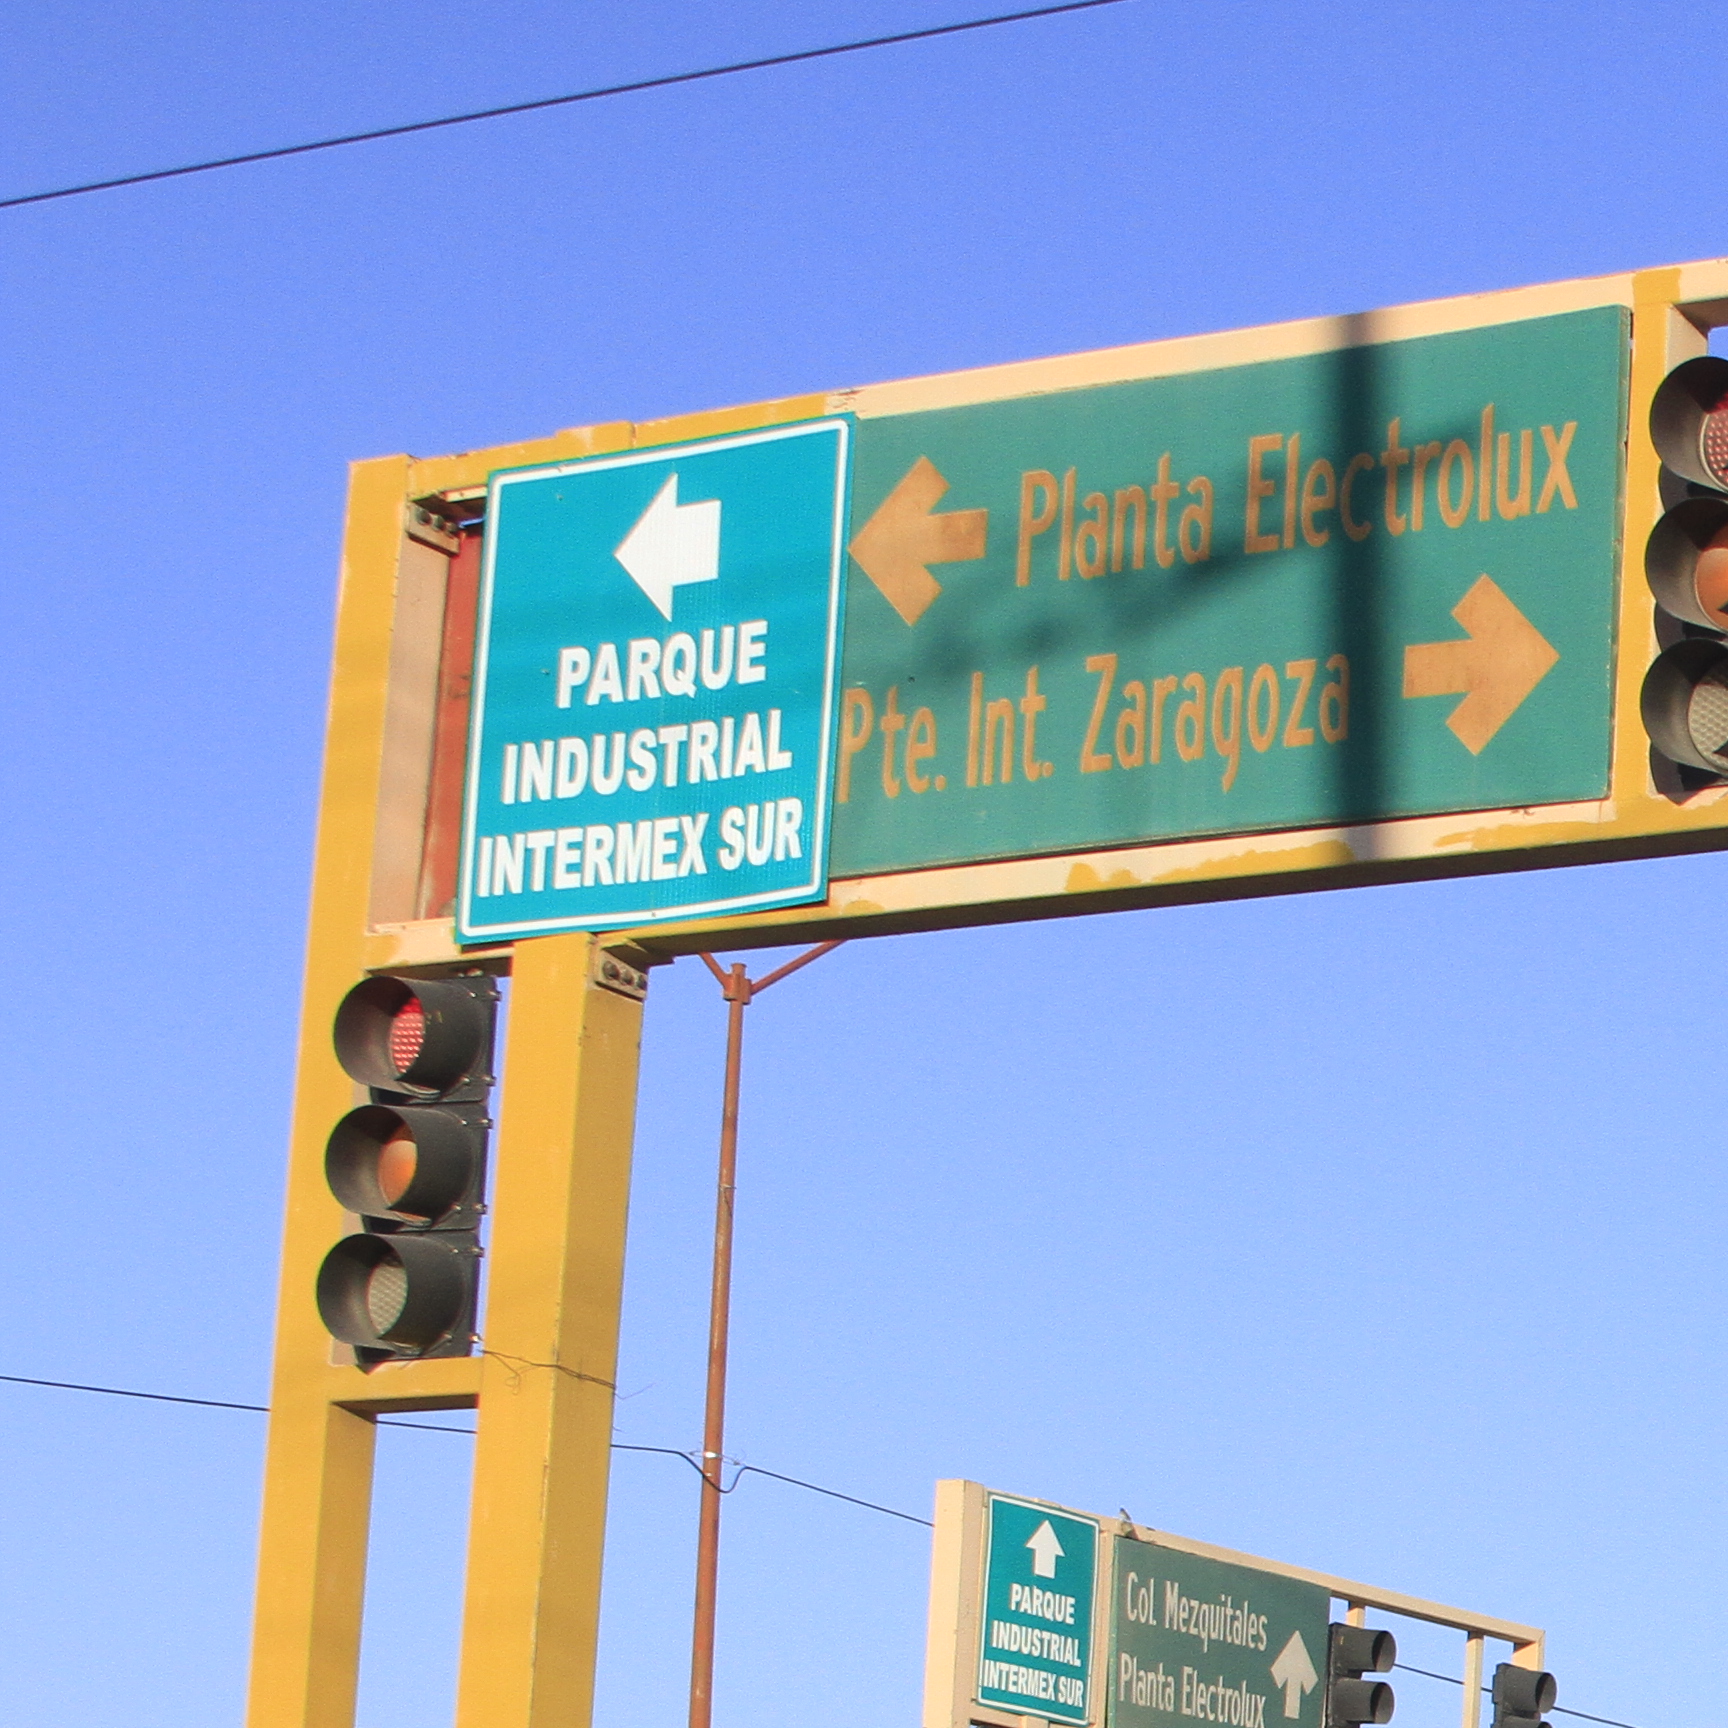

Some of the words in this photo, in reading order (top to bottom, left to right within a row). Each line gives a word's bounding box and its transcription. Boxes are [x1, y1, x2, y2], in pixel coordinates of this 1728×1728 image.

[1016, 452, 1215, 587] Planta
[1245, 402, 1580, 556] Electrolux
[556, 620, 769, 708] PARQUE
[502, 708, 792, 805] INDUSTRIAL
[843, 686, 946, 804] Pte.
[966, 668, 1053, 785] Int.
[1080, 650, 1351, 794] Zaragoza
[478, 811, 709, 898] INTERMEX
[716, 797, 804, 868] SUR
[991, 1620, 1082, 1666] INDUSTRIAL
[1010, 1582, 1075, 1625] PARQUE
[1127, 1571, 1157, 1622] Col.
[1165, 1579, 1268, 1653] Mezquitales
[983, 1659, 1055, 1703] INTERMEX
[1058, 1678, 1084, 1708] SUR
[1119, 1652, 1175, 1713] Planta
